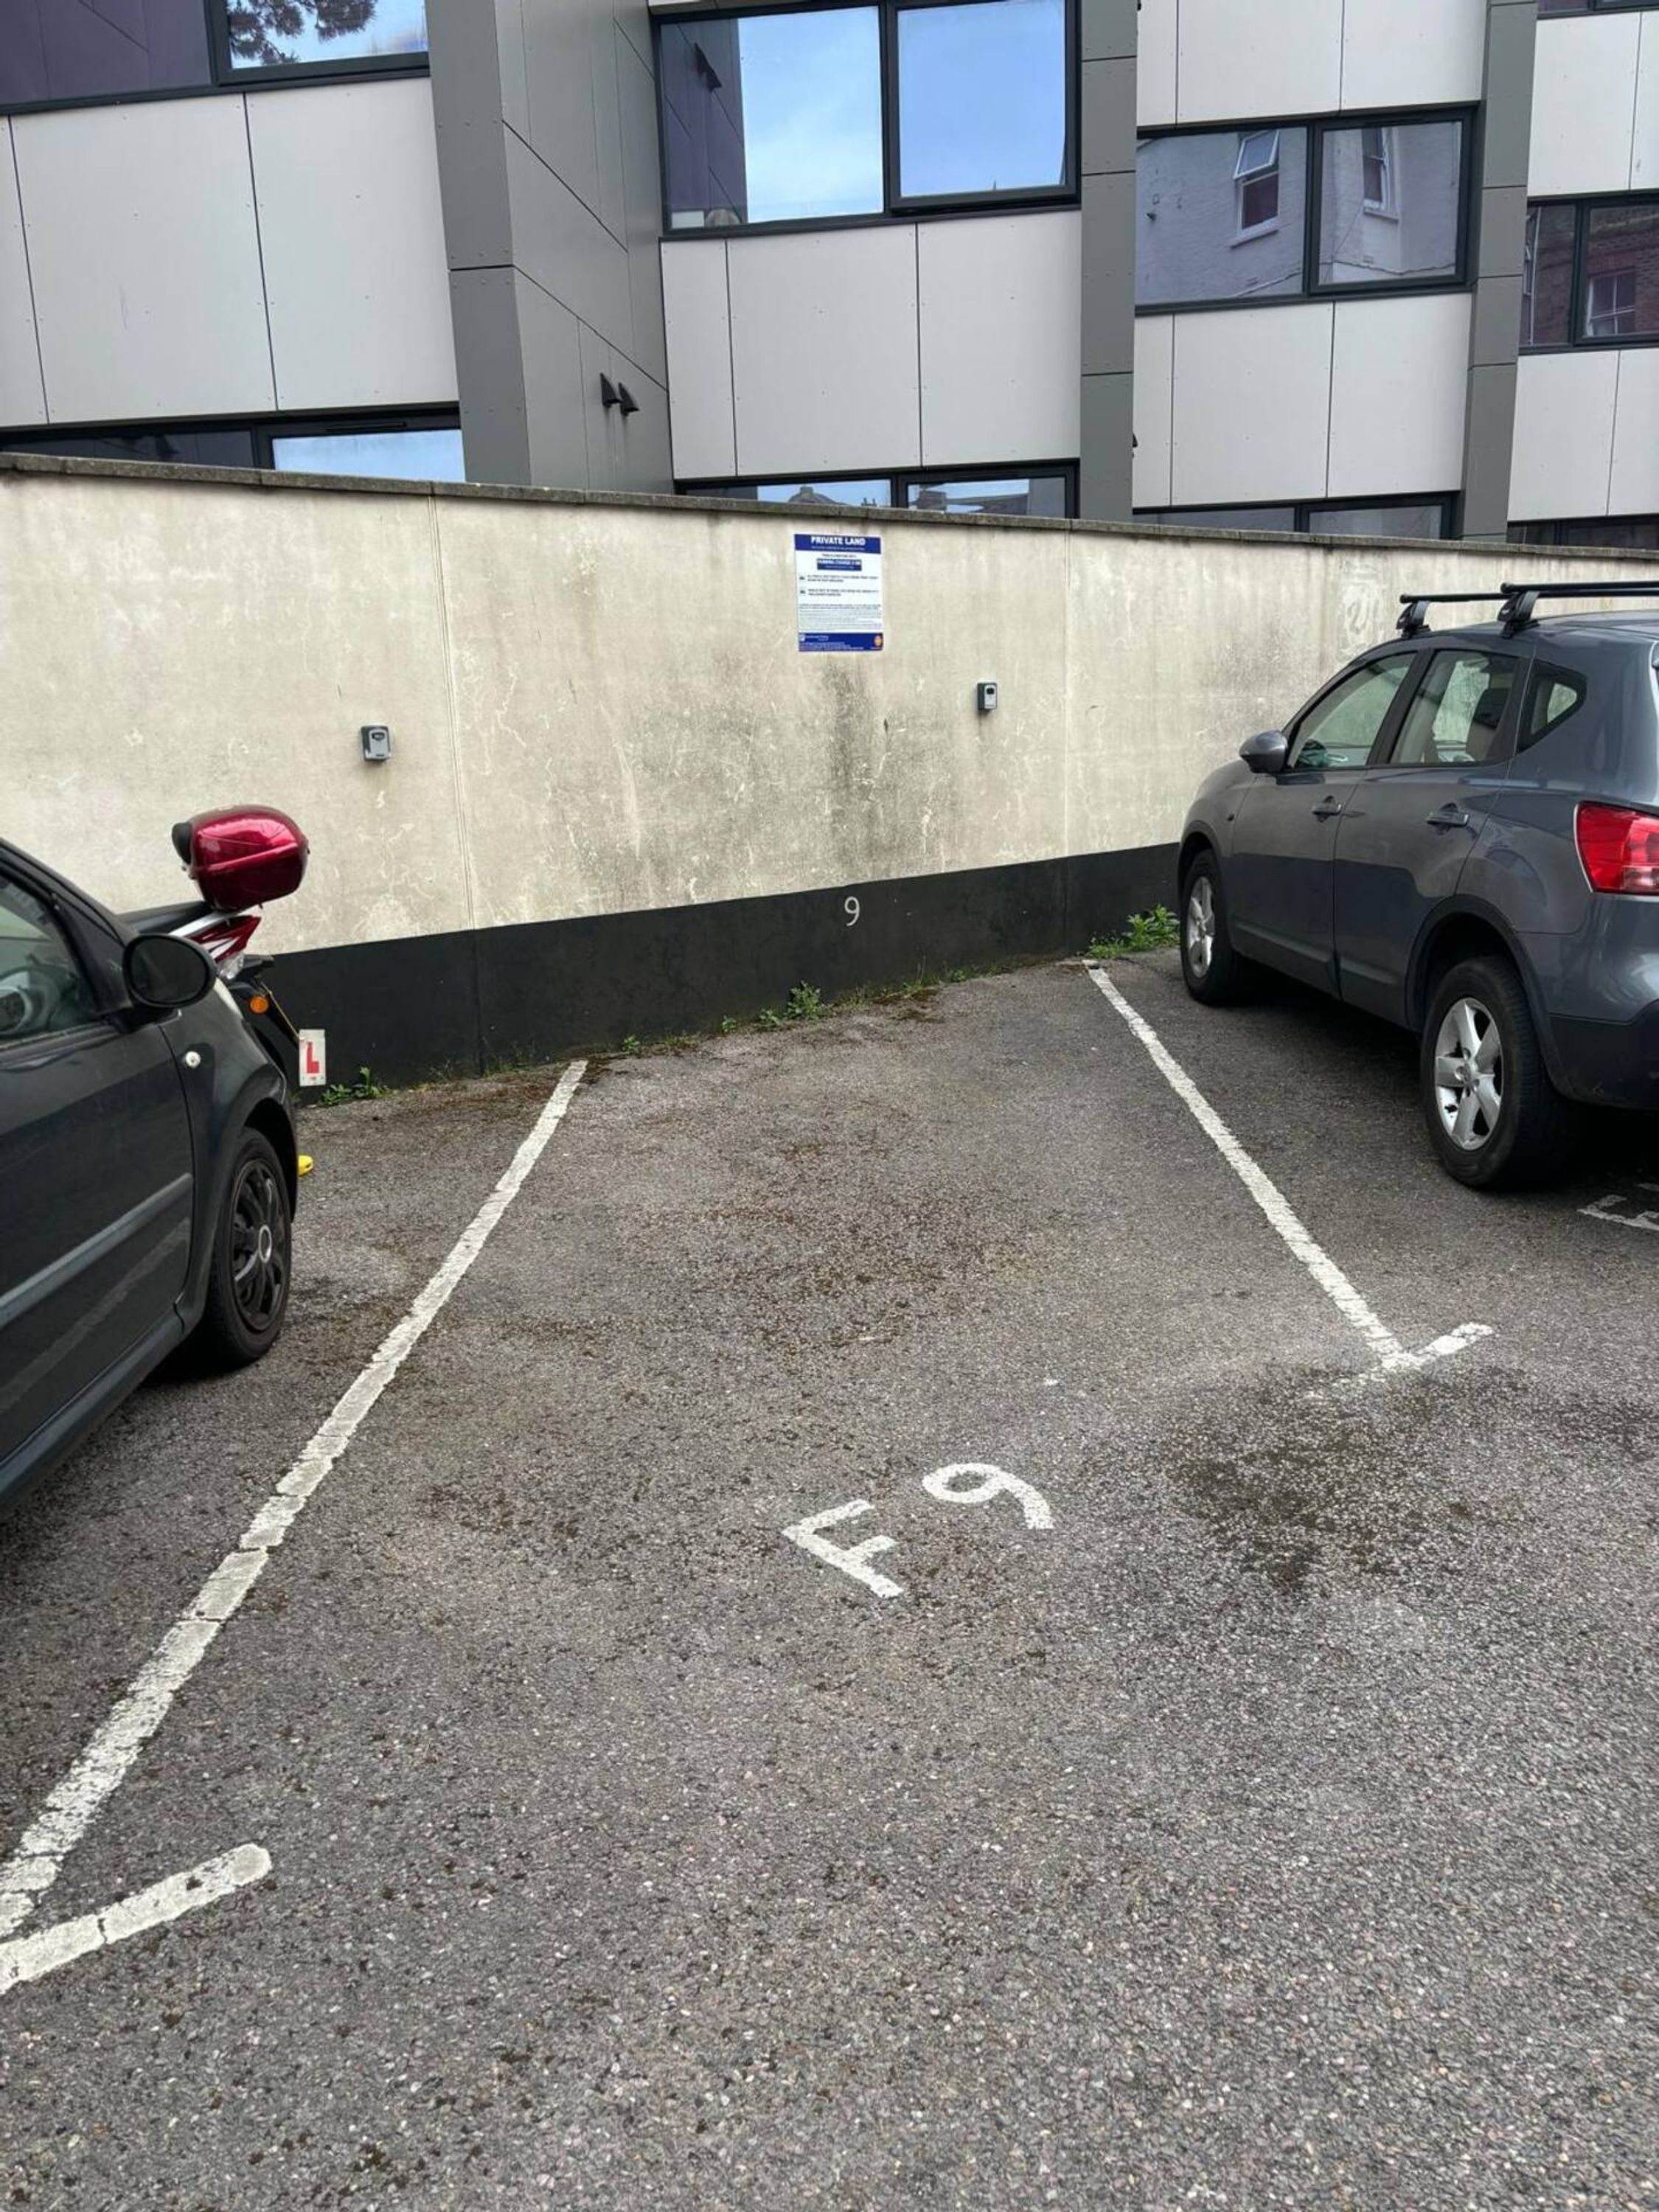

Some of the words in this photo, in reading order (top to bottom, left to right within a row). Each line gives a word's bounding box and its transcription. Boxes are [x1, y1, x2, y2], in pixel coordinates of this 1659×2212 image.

[811, 536, 844, 545] PRIVATE
[844, 537, 866, 546] LAND
[844, 896, 860, 927] 9
[306, 1041, 320, 1074] L
